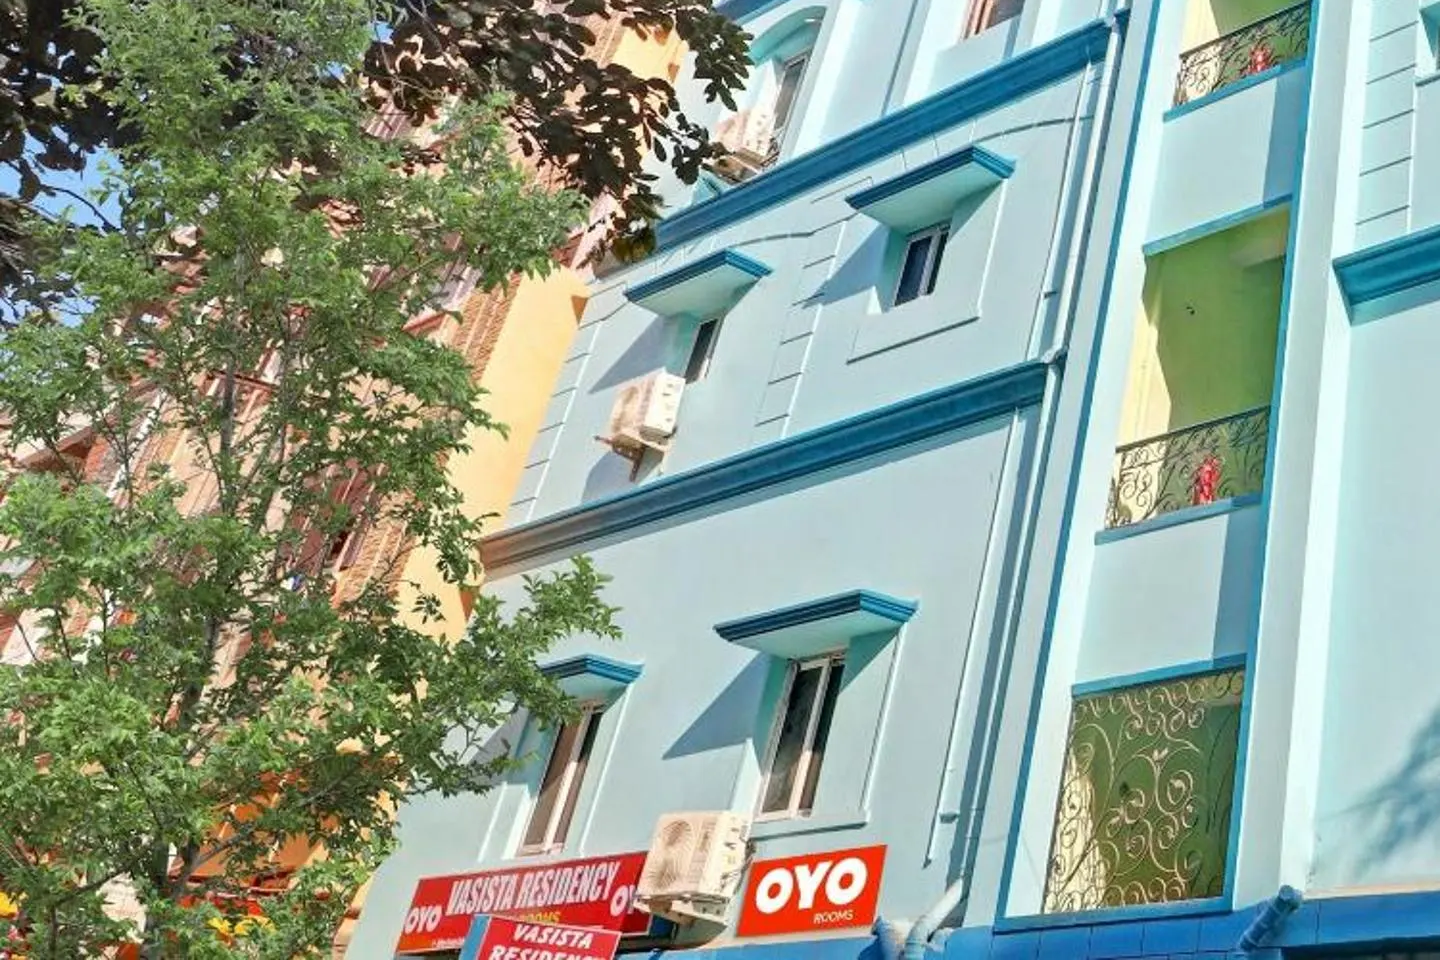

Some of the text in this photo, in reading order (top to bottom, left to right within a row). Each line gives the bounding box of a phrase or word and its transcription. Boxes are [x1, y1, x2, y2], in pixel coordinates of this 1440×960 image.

[445, 861, 621, 916] VASISTA RESIDENCY
[755, 857, 868, 914] OYO
[404, 904, 442, 934] OYO
[520, 911, 561, 924] OOMS
[813, 909, 854, 924] ROOMS
[513, 924, 594, 949] VASISTA
